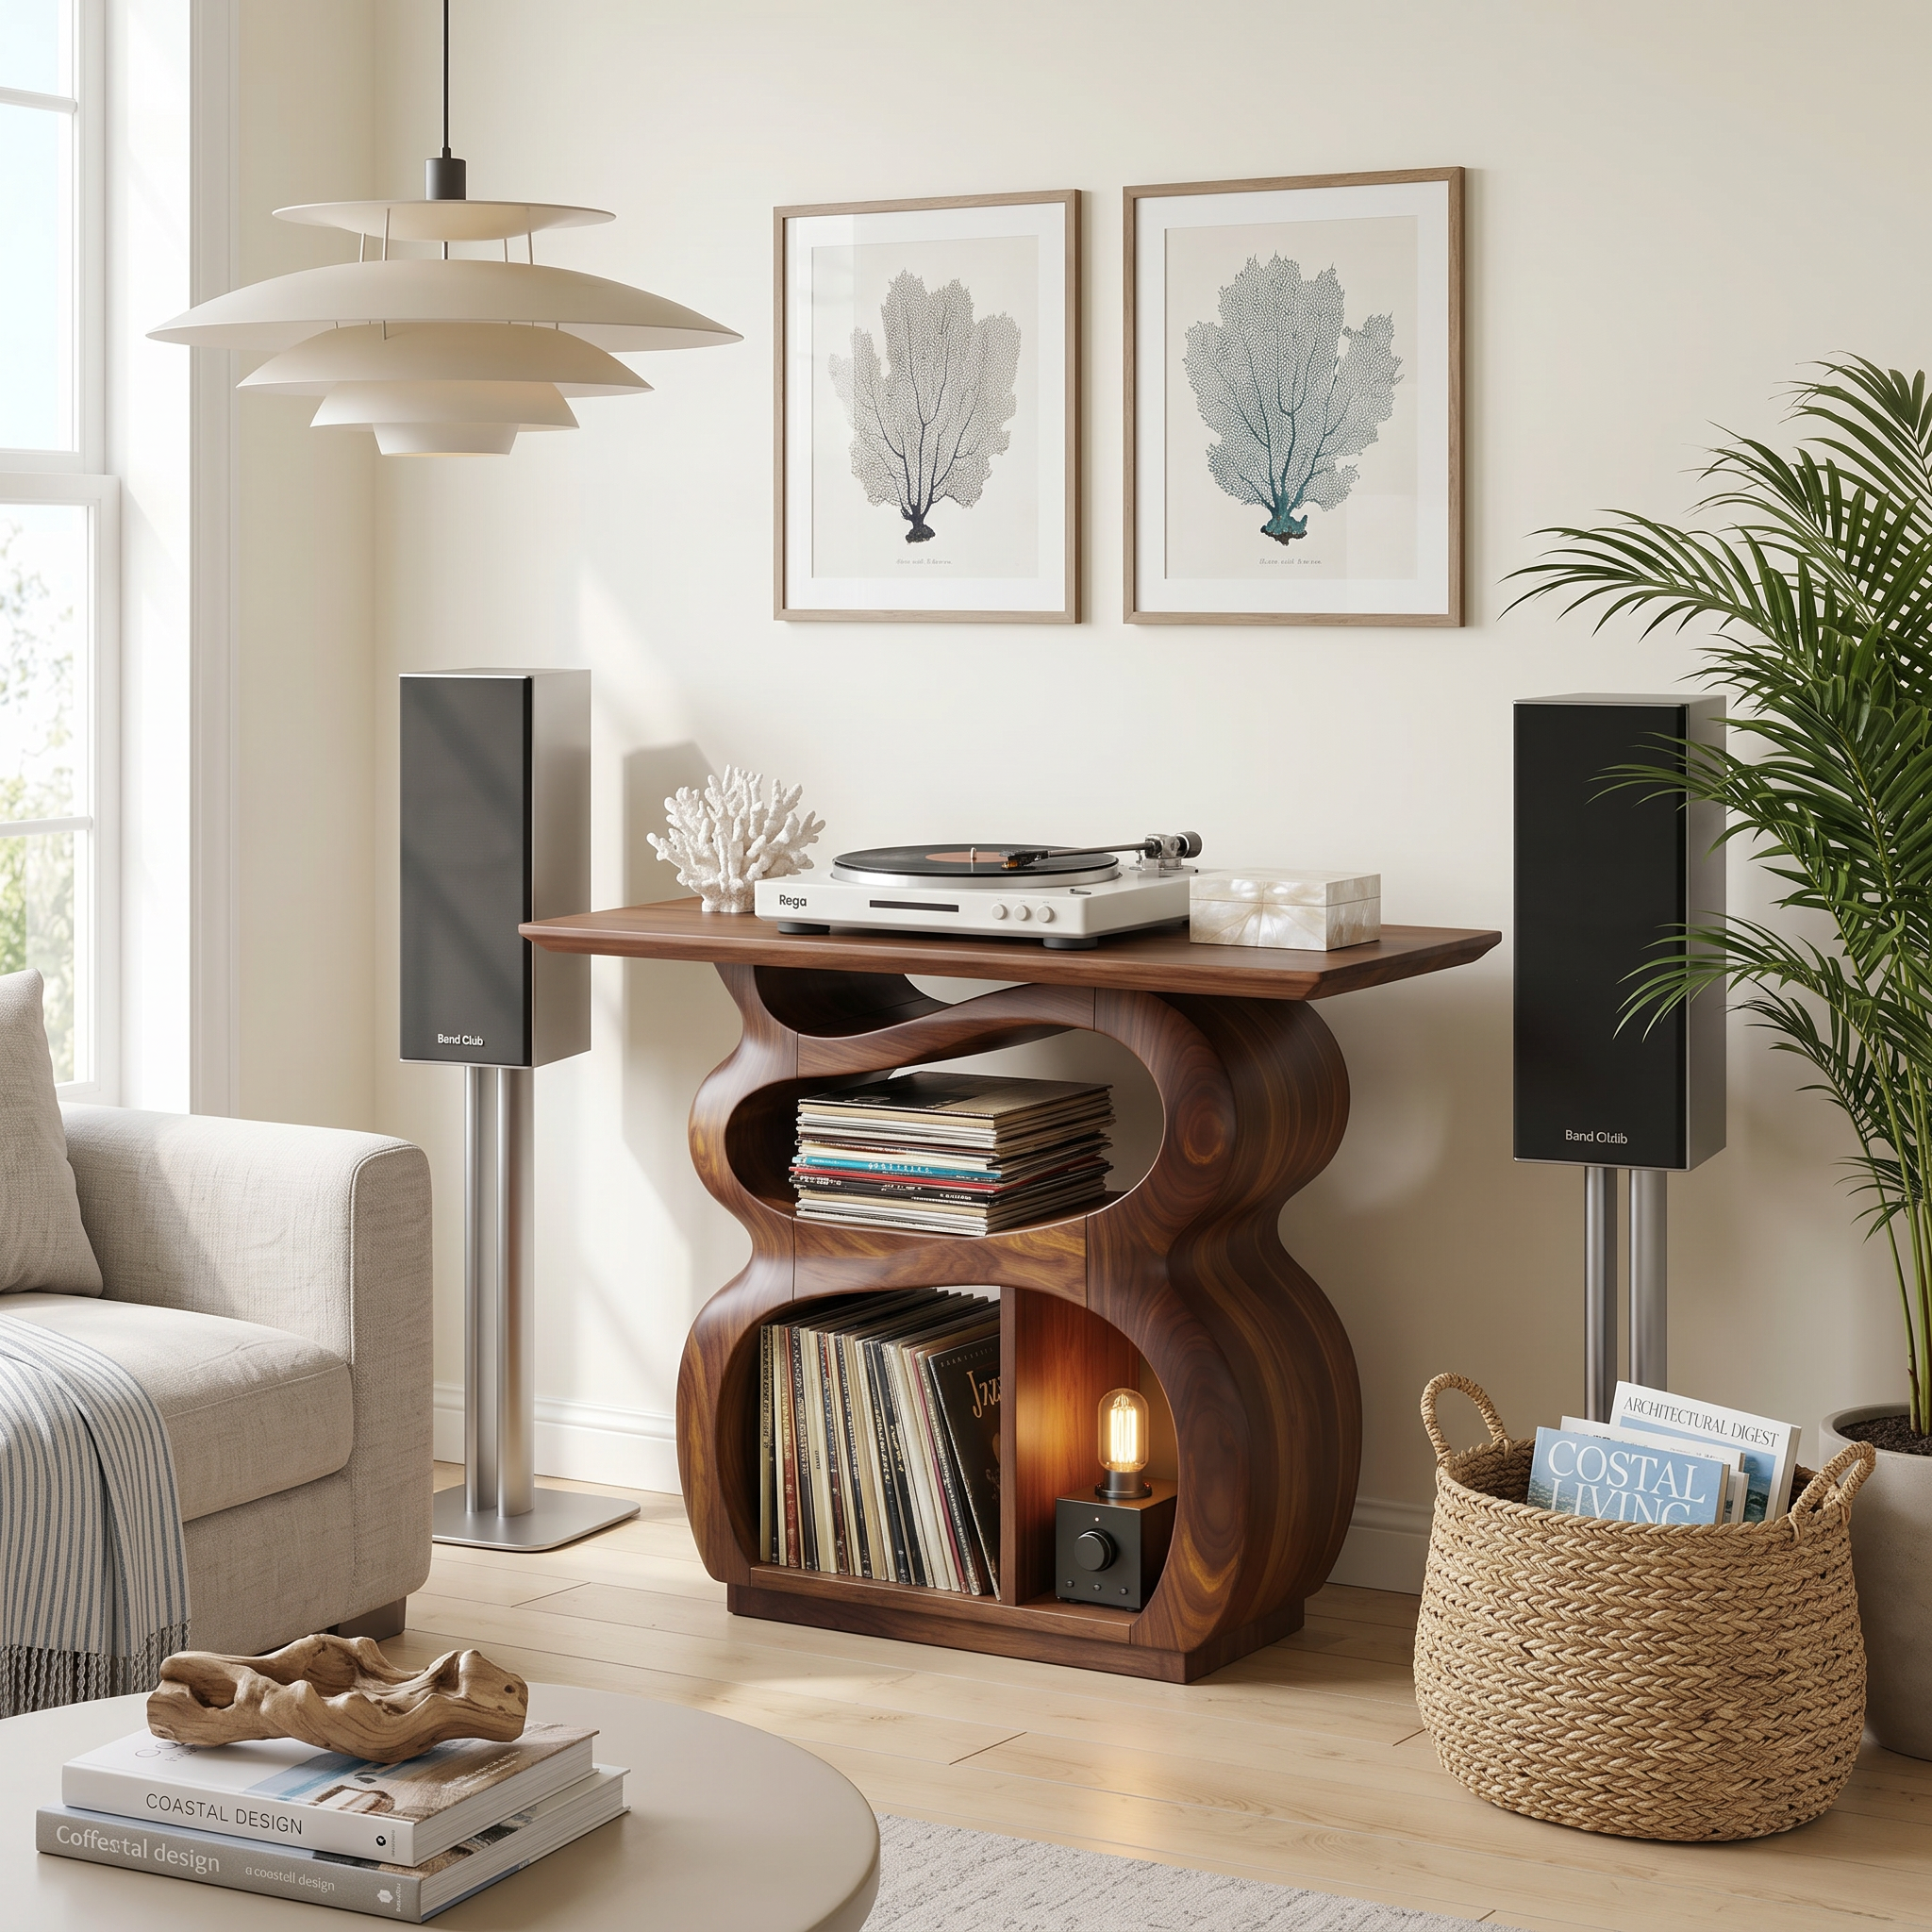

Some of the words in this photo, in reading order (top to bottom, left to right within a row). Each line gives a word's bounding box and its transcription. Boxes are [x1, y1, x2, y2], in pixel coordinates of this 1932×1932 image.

[779, 894, 807, 909] Rega
[1565, 1129, 1594, 1142] Band
[1623, 1396, 1728, 1435] ARCHITECTURAL
[1731, 1423, 1780, 1448] DIGEST
[1548, 1440, 1707, 1504] COSTAL
[145, 1793, 229, 1822] COASTAL
[235, 1808, 303, 1835] DESIGN
[154, 1842, 220, 1874] design
[298, 1874, 335, 1893] design
